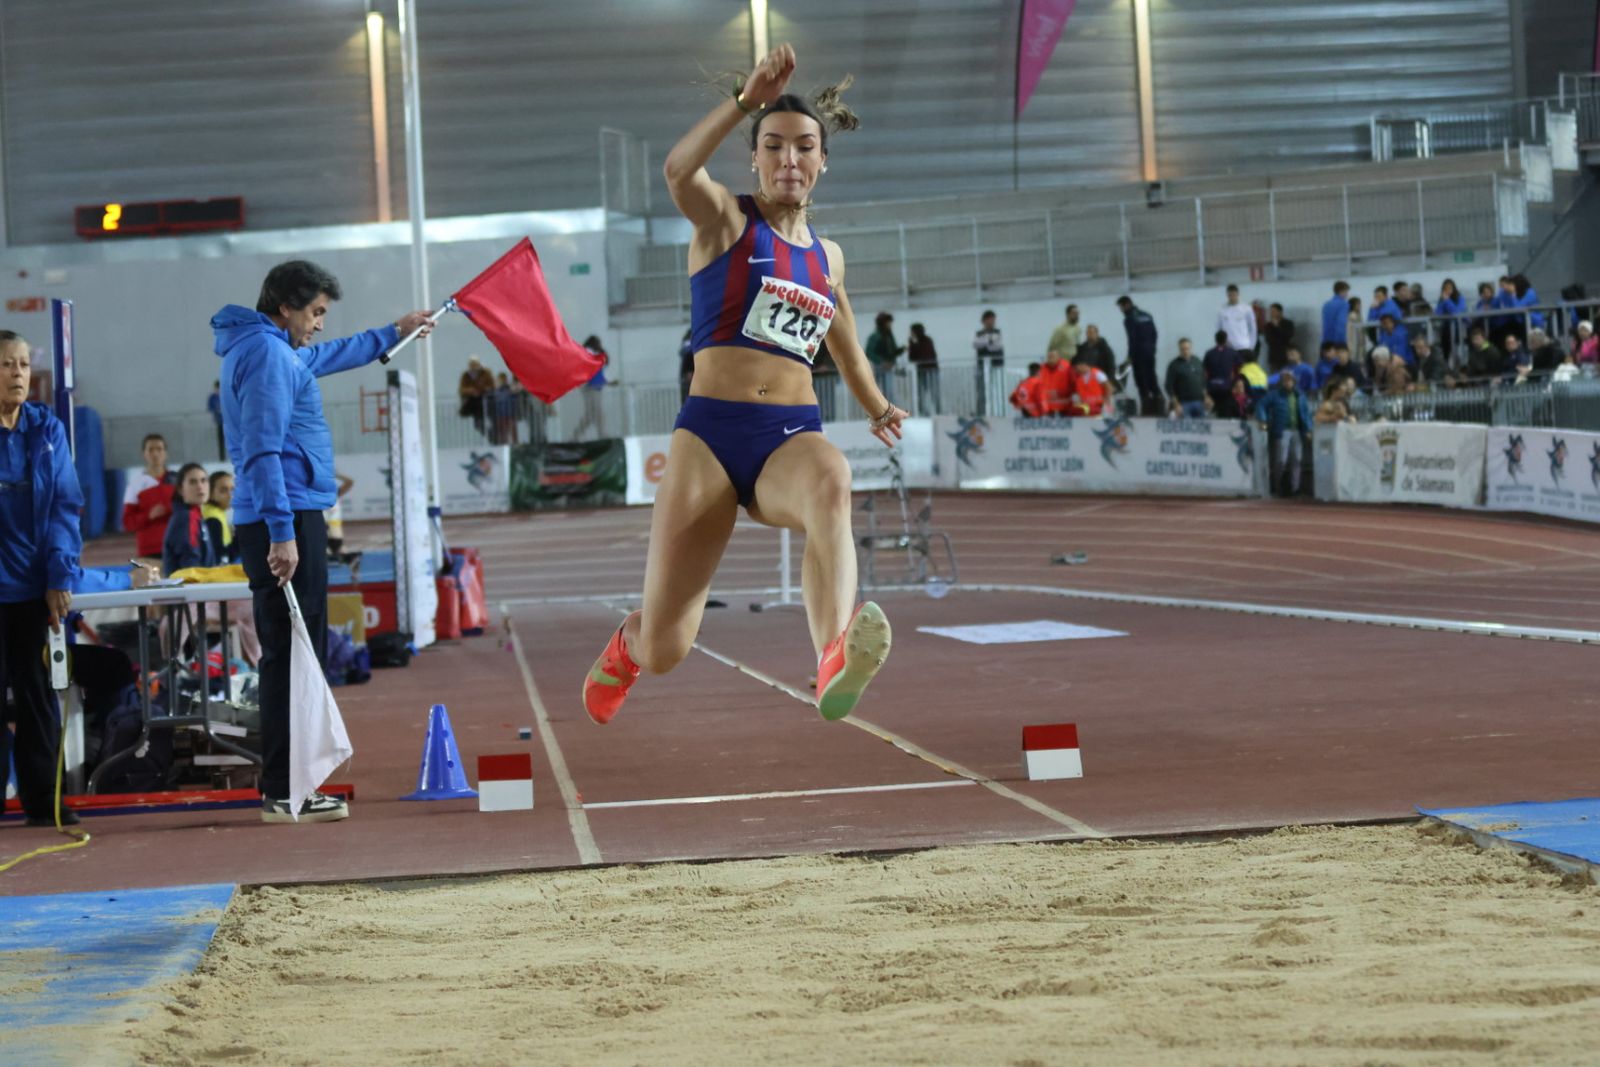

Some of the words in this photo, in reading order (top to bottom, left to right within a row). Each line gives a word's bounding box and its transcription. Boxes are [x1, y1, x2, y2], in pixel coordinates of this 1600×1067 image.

[103, 203, 121, 230] 2
[768, 301, 819, 341] 120
[1019, 437, 1069, 451] ATLETISMO
[1160, 440, 1208, 456] ATLETISMO
[1004, 457, 1049, 473] CASTILLA
[1146, 461, 1189, 477] CASTILLA
